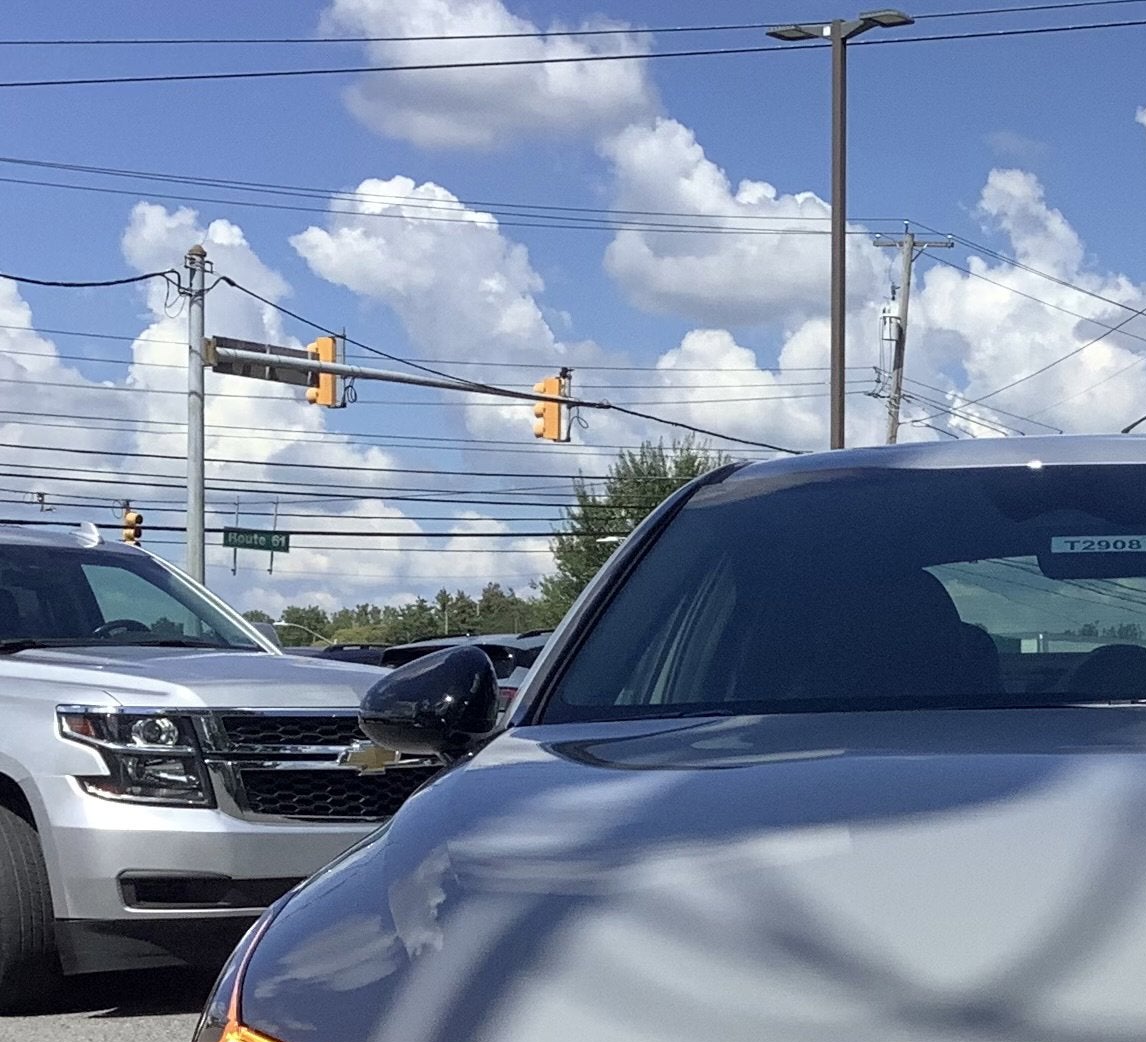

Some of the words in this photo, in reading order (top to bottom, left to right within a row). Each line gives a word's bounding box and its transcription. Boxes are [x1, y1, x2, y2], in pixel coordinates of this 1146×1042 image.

[228, 532, 266, 546] Route
[271, 534, 286, 547] 61
[1063, 539, 1142, 551] T2908
